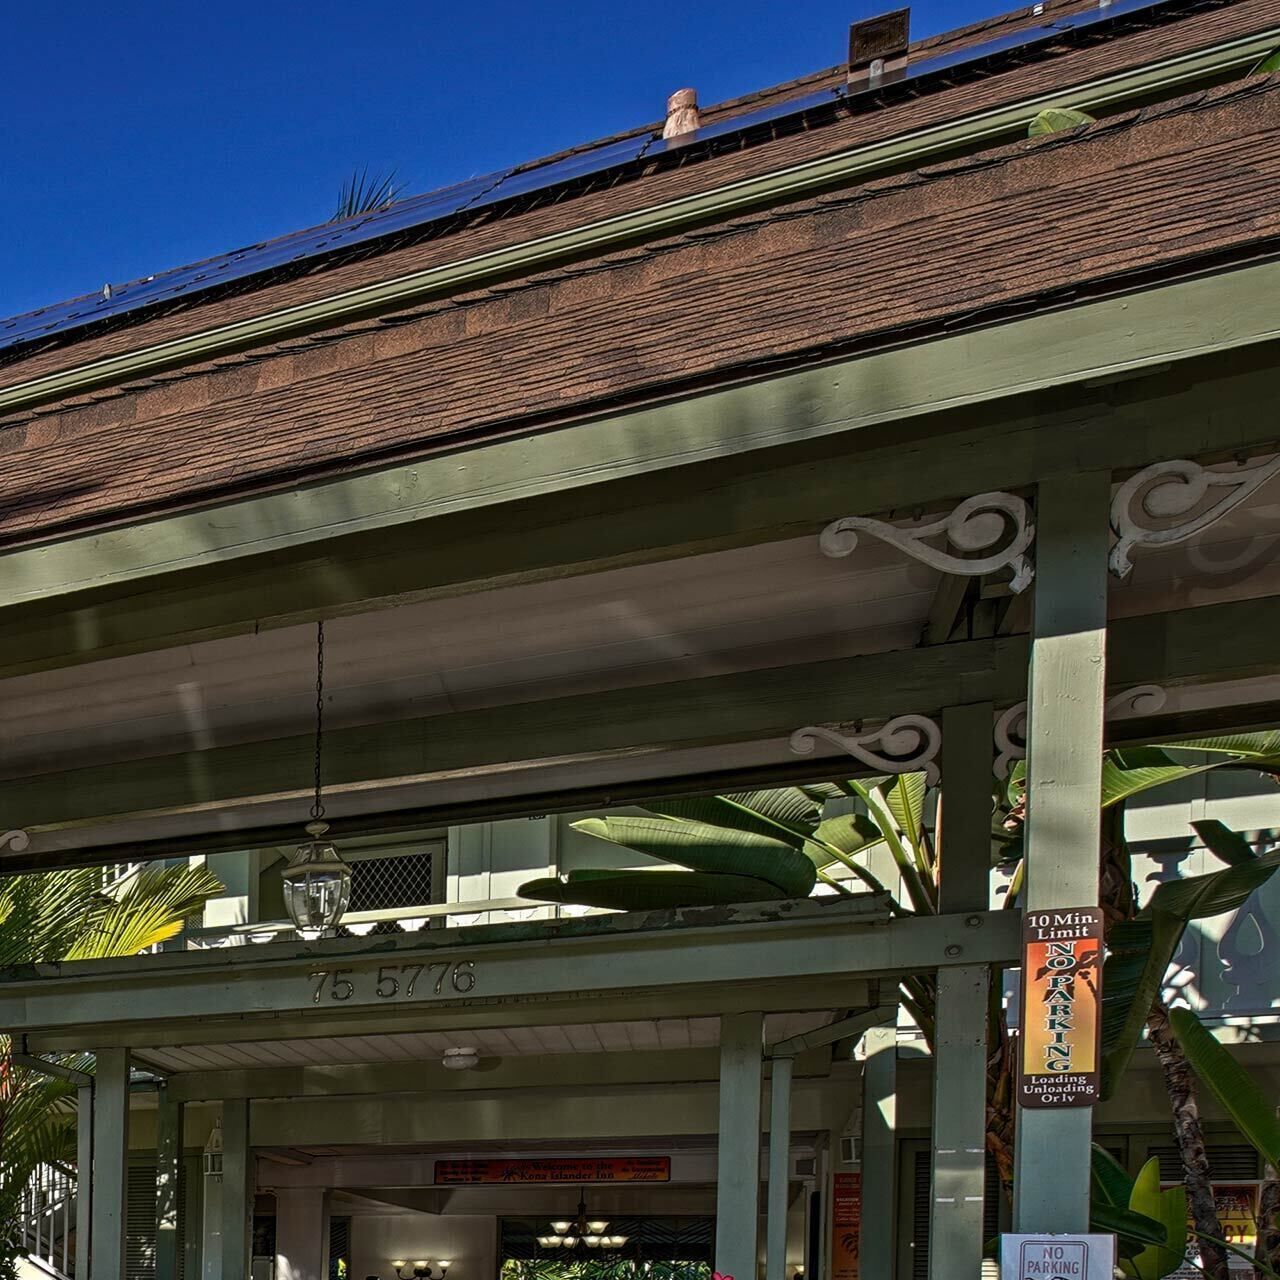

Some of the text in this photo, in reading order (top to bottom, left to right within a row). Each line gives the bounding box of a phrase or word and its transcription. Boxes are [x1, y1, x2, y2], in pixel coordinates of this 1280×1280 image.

[1028, 912, 1099, 928] 10 Min.
[1037, 926, 1089, 940] Limit
[307, 960, 477, 1004] 75 5776
[1043, 941, 1077, 1073] NO PARKING
[1031, 1074, 1087, 1085] Loading
[1023, 1084, 1095, 1095] Unloading
[1043, 1246, 1064, 1259] NO
[1027, 1260, 1080, 1275] PARKING
